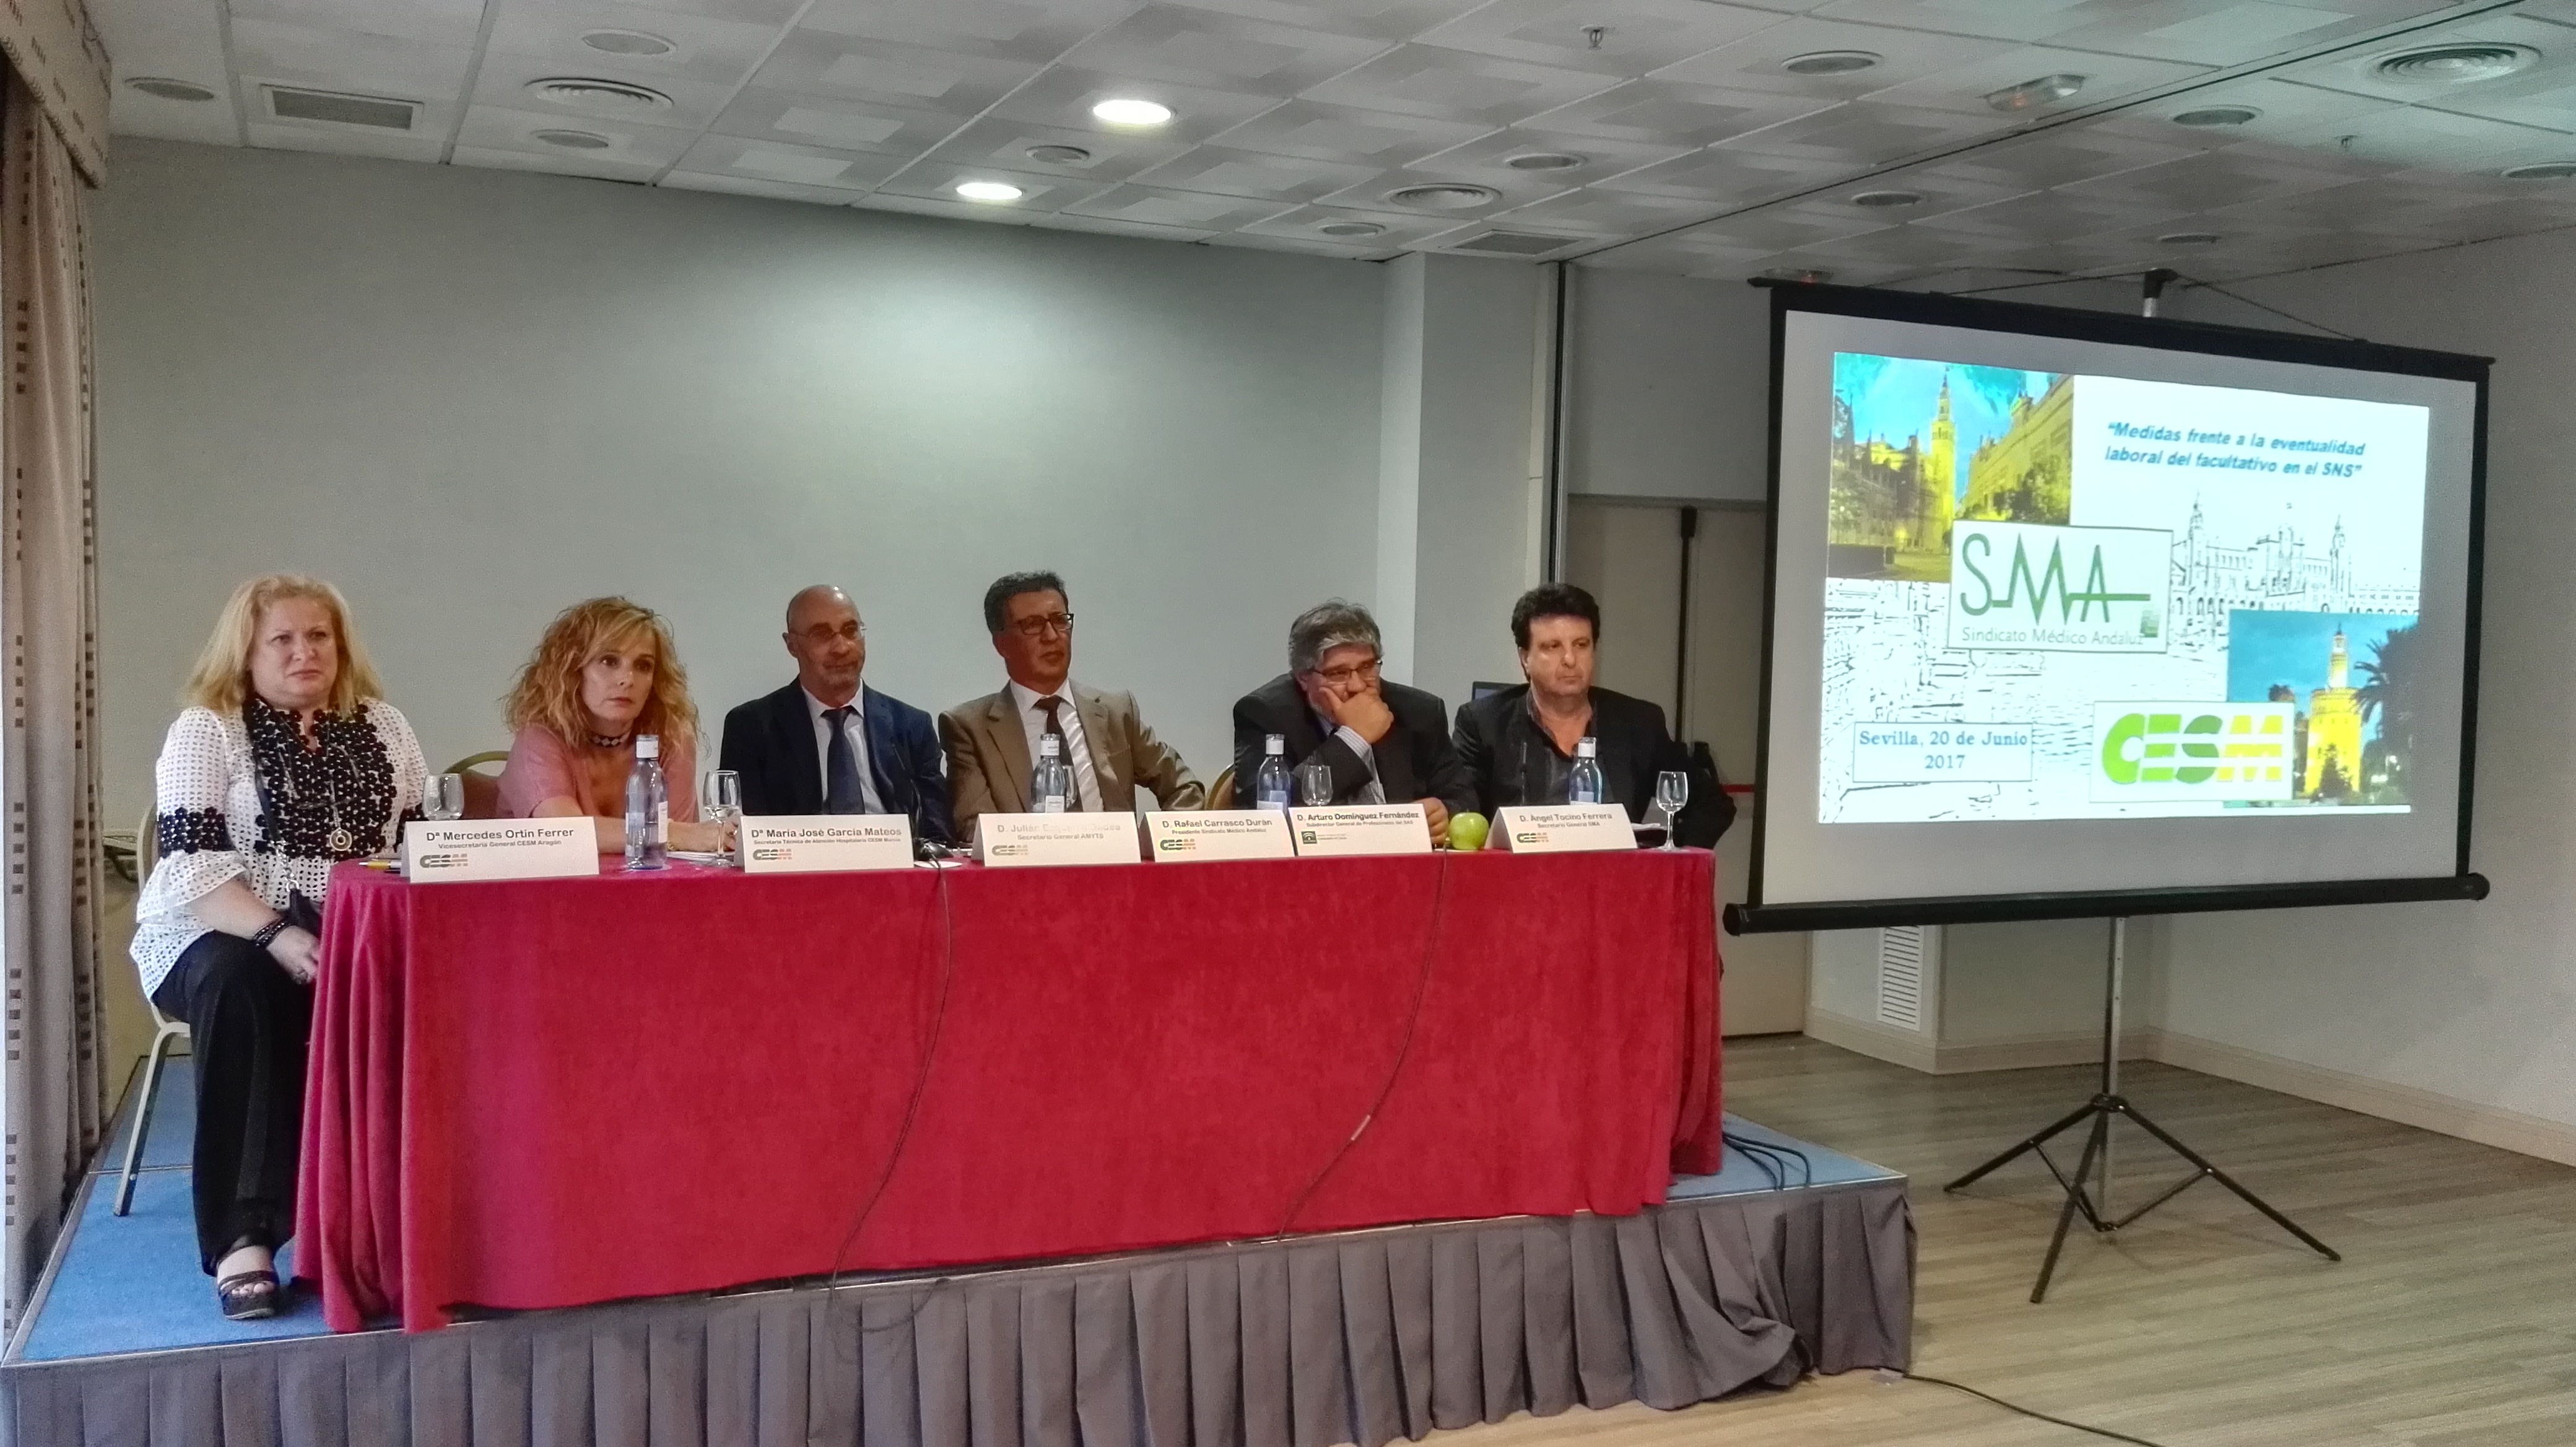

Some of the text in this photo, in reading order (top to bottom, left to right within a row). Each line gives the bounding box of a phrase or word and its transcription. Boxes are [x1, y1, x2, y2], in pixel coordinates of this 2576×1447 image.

[2187, 428, 2230, 445] frente
[2235, 435, 2246, 446] a
[2250, 433, 2266, 448] la
[2270, 437, 2365, 457] eventualidad
[2104, 446, 2163, 464] laboral
[2167, 451, 2191, 466] del
[2195, 452, 2277, 473] facultativo
[2282, 462, 2300, 474] en
[2304, 461, 2318, 475] el
[1960, 532, 2151, 626] SMA
[1962, 626, 2144, 645] Sindicato Médico Andaluz
[1858, 730, 2028, 750] Sevilla, 20 de Junio
[2102, 713, 2284, 785] CESM
[1925, 754, 1965, 770] 2017
[799, 828, 824, 837] José
[864, 828, 902, 836] Mateos
[1174, 820, 1203, 828] Rafael
[1204, 819, 1245, 827] Carrasco
[1246, 818, 1273, 826] Durán
[444, 831, 502, 840] Mercedes
[537, 829, 574, 837] Ferrer
